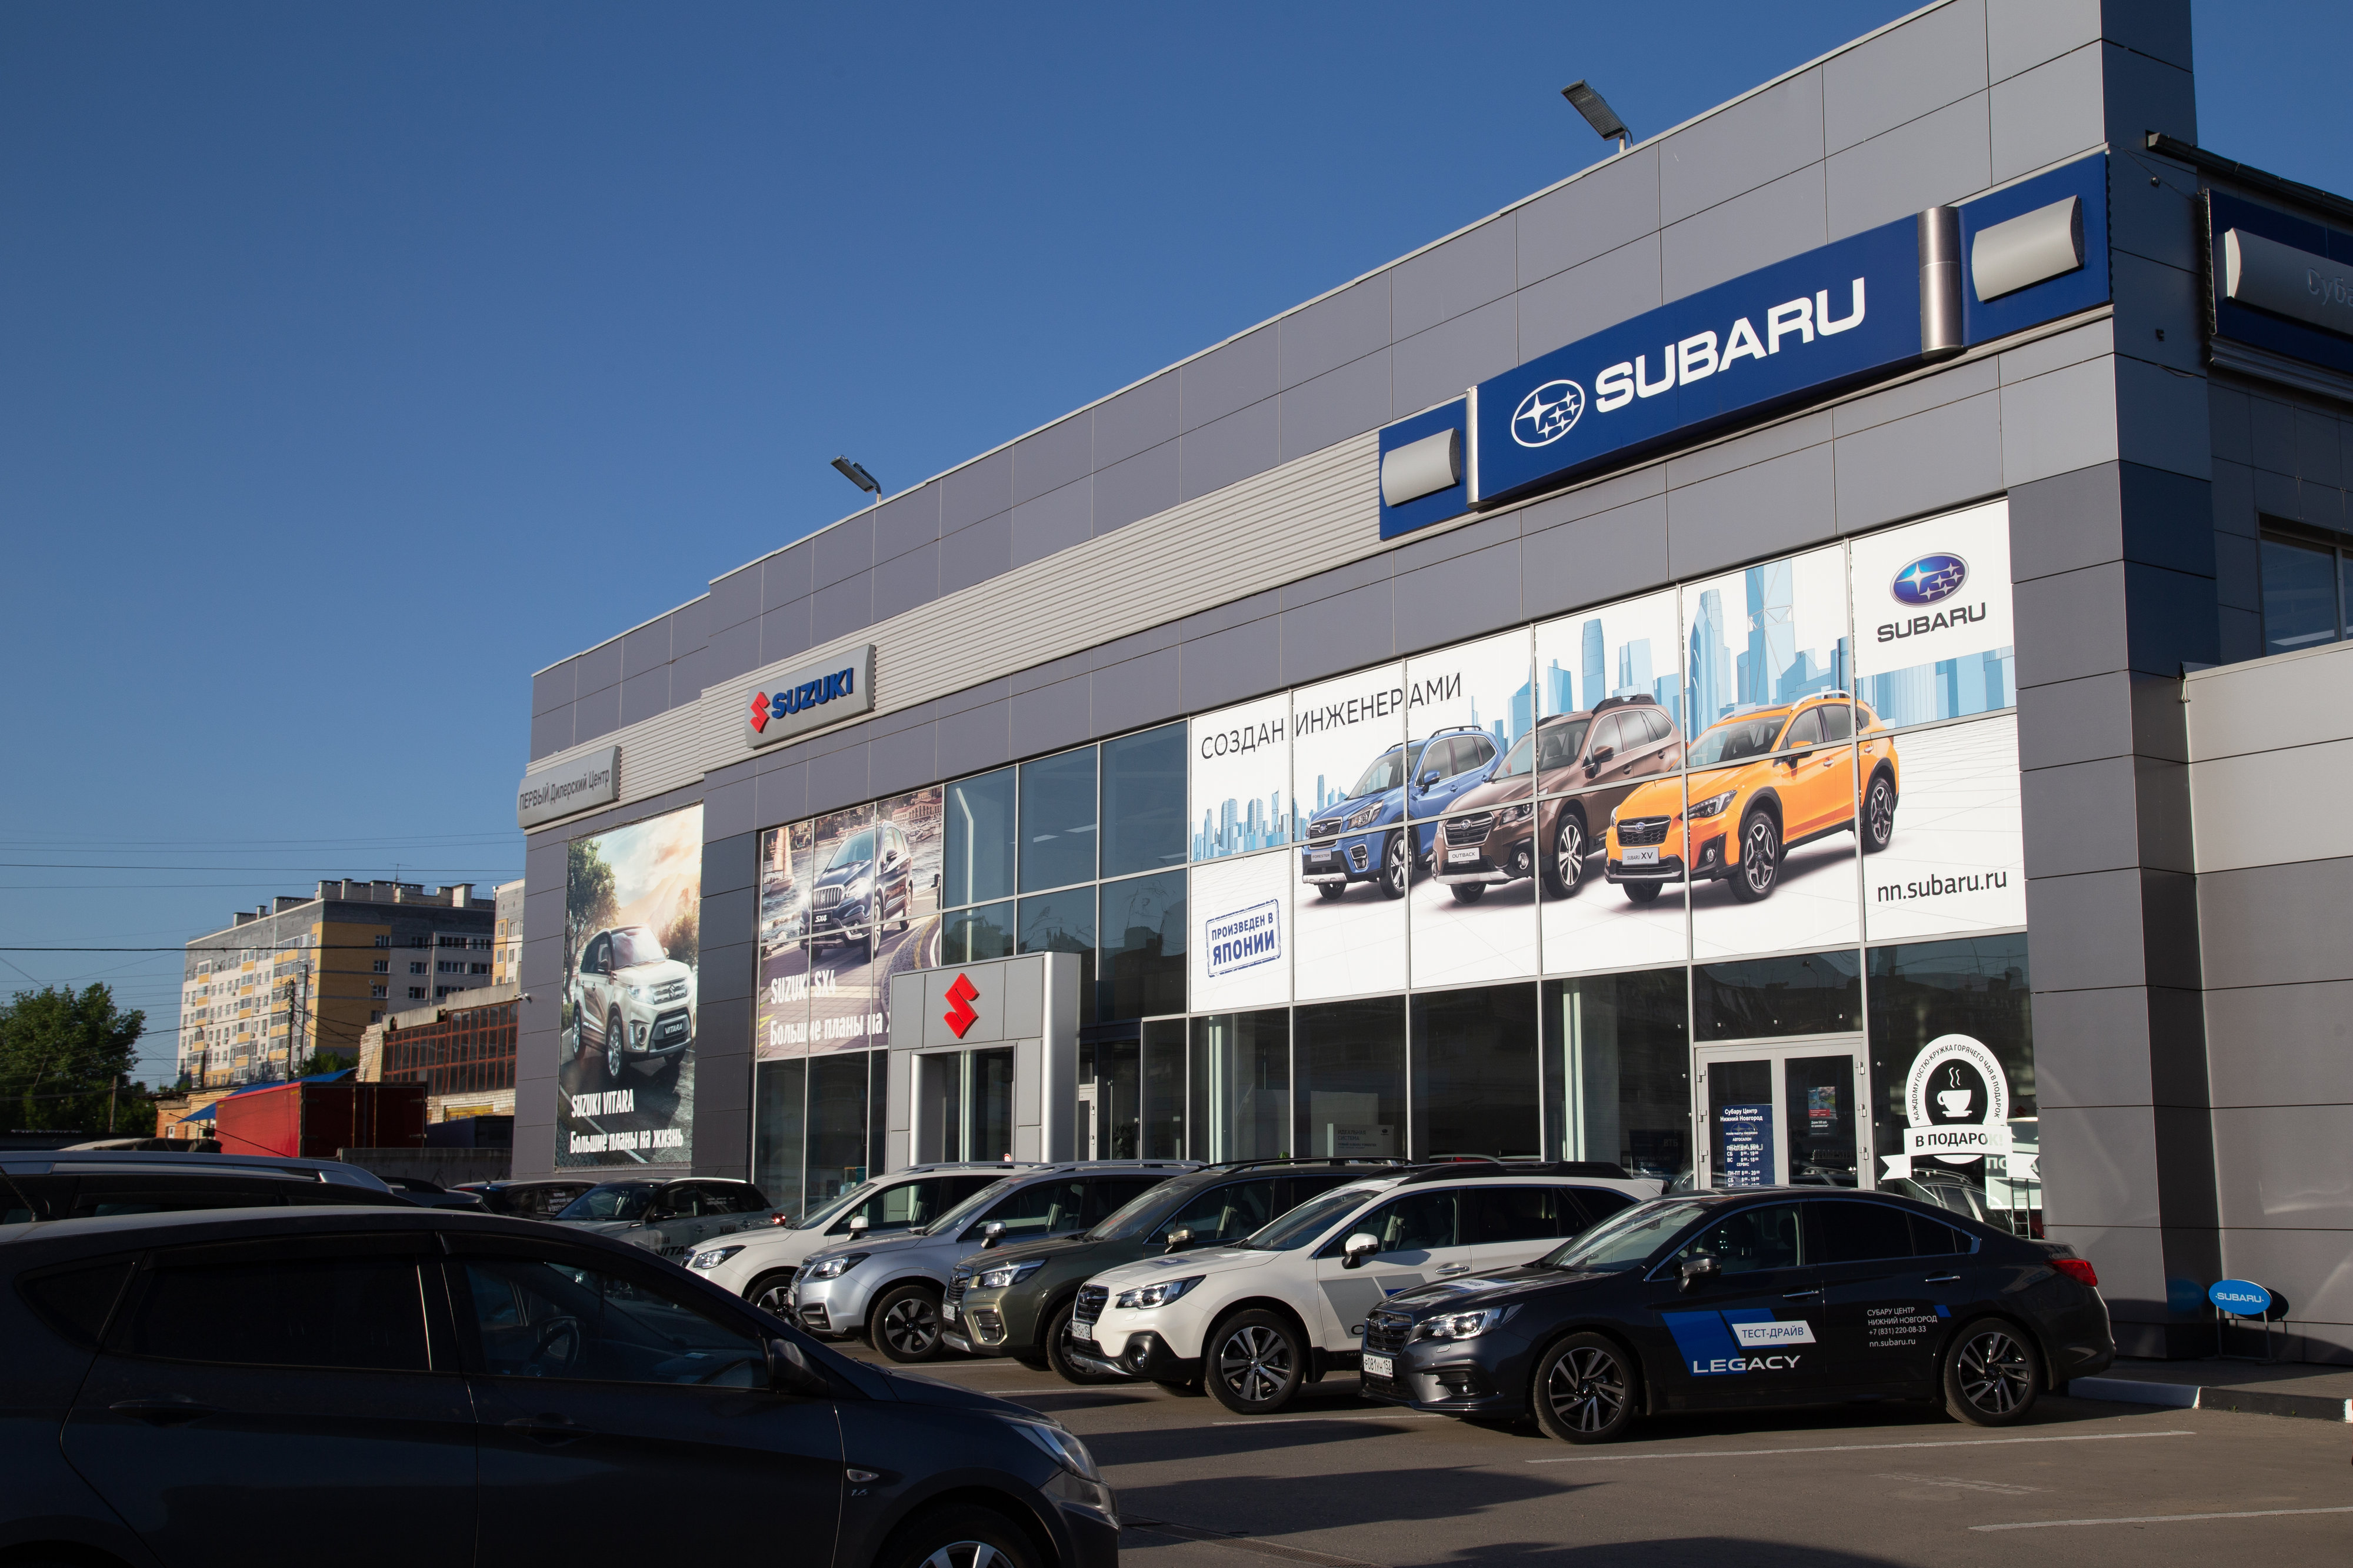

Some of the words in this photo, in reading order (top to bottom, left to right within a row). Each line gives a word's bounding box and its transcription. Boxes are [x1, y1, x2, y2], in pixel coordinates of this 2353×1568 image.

[1595, 276, 1865, 413] SUBARU
[1878, 603, 1987, 643] SUBARU
[771, 667, 854, 719] SUZUKI
[1201, 718, 1284, 759] СОЗДАН
[1295, 672, 1462, 737] ИНЖЕНЕРАМИ
[519, 782, 549, 810] ПЕРВЫЙ
[550, 772, 587, 805] Дилерский
[589, 769, 609, 790] Центр
[1878, 869, 2008, 903] nn.subaru.ru
[815, 915, 827, 923] SX4
[1212, 915, 1265, 941] ПРОИЗВЕДЕН
[1268, 912, 1273, 924] В
[1213, 929, 1275, 966] ЯПОНИИ
[771, 973, 809, 1005] SUZUKI
[814, 969, 836, 997] SX4
[665, 1023, 682, 1034] VITARA
[770, 1019, 821, 1046] Большие
[825, 1015, 864, 1040] планы
[1915, 1045, 1953, 1082] ГОСТЮ-КРУЖКА
[1954, 1044, 1984, 1062] ГОРЯЧЕГО
[1984, 1060, 1994, 1075] ЧАЯ
[571, 1093, 601, 1117] SUZUKI
[603, 1089, 634, 1115] VITARA
[1912, 1082, 1920, 1121] КАЖДОМУ
[1992, 1081, 2001, 1119] ПОДАРОК
[570, 1131, 608, 1154] Большие
[609, 1131, 638, 1152] планы
[639, 1130, 651, 1149] на
[652, 1128, 684, 1148] жизнь
[1915, 1135, 1925, 1147] В
[655, 1245, 686, 1257] VITA
[2217, 1292, 2262, 1303] SUBARU
[1868, 1316, 1898, 1326] НИЖНИЙ
[1899, 1315, 1938, 1324] НОВГОРОД
[1894, 1307, 1915, 1315] ЦЕНТР
[1742, 1325, 1804, 1339] ТЕСТ-ДРАЙВ
[1869, 1338, 1916, 1347] nn.subaru.ru
[1878, 1327, 1894, 1336] (831)
[1895, 1326, 1927, 1334] 220-08-33
[1365, 1357, 1383, 1373] Р081УН
[1383, 1360, 1391, 1370] 152
[1693, 1355, 1801, 1373] LEGACY
